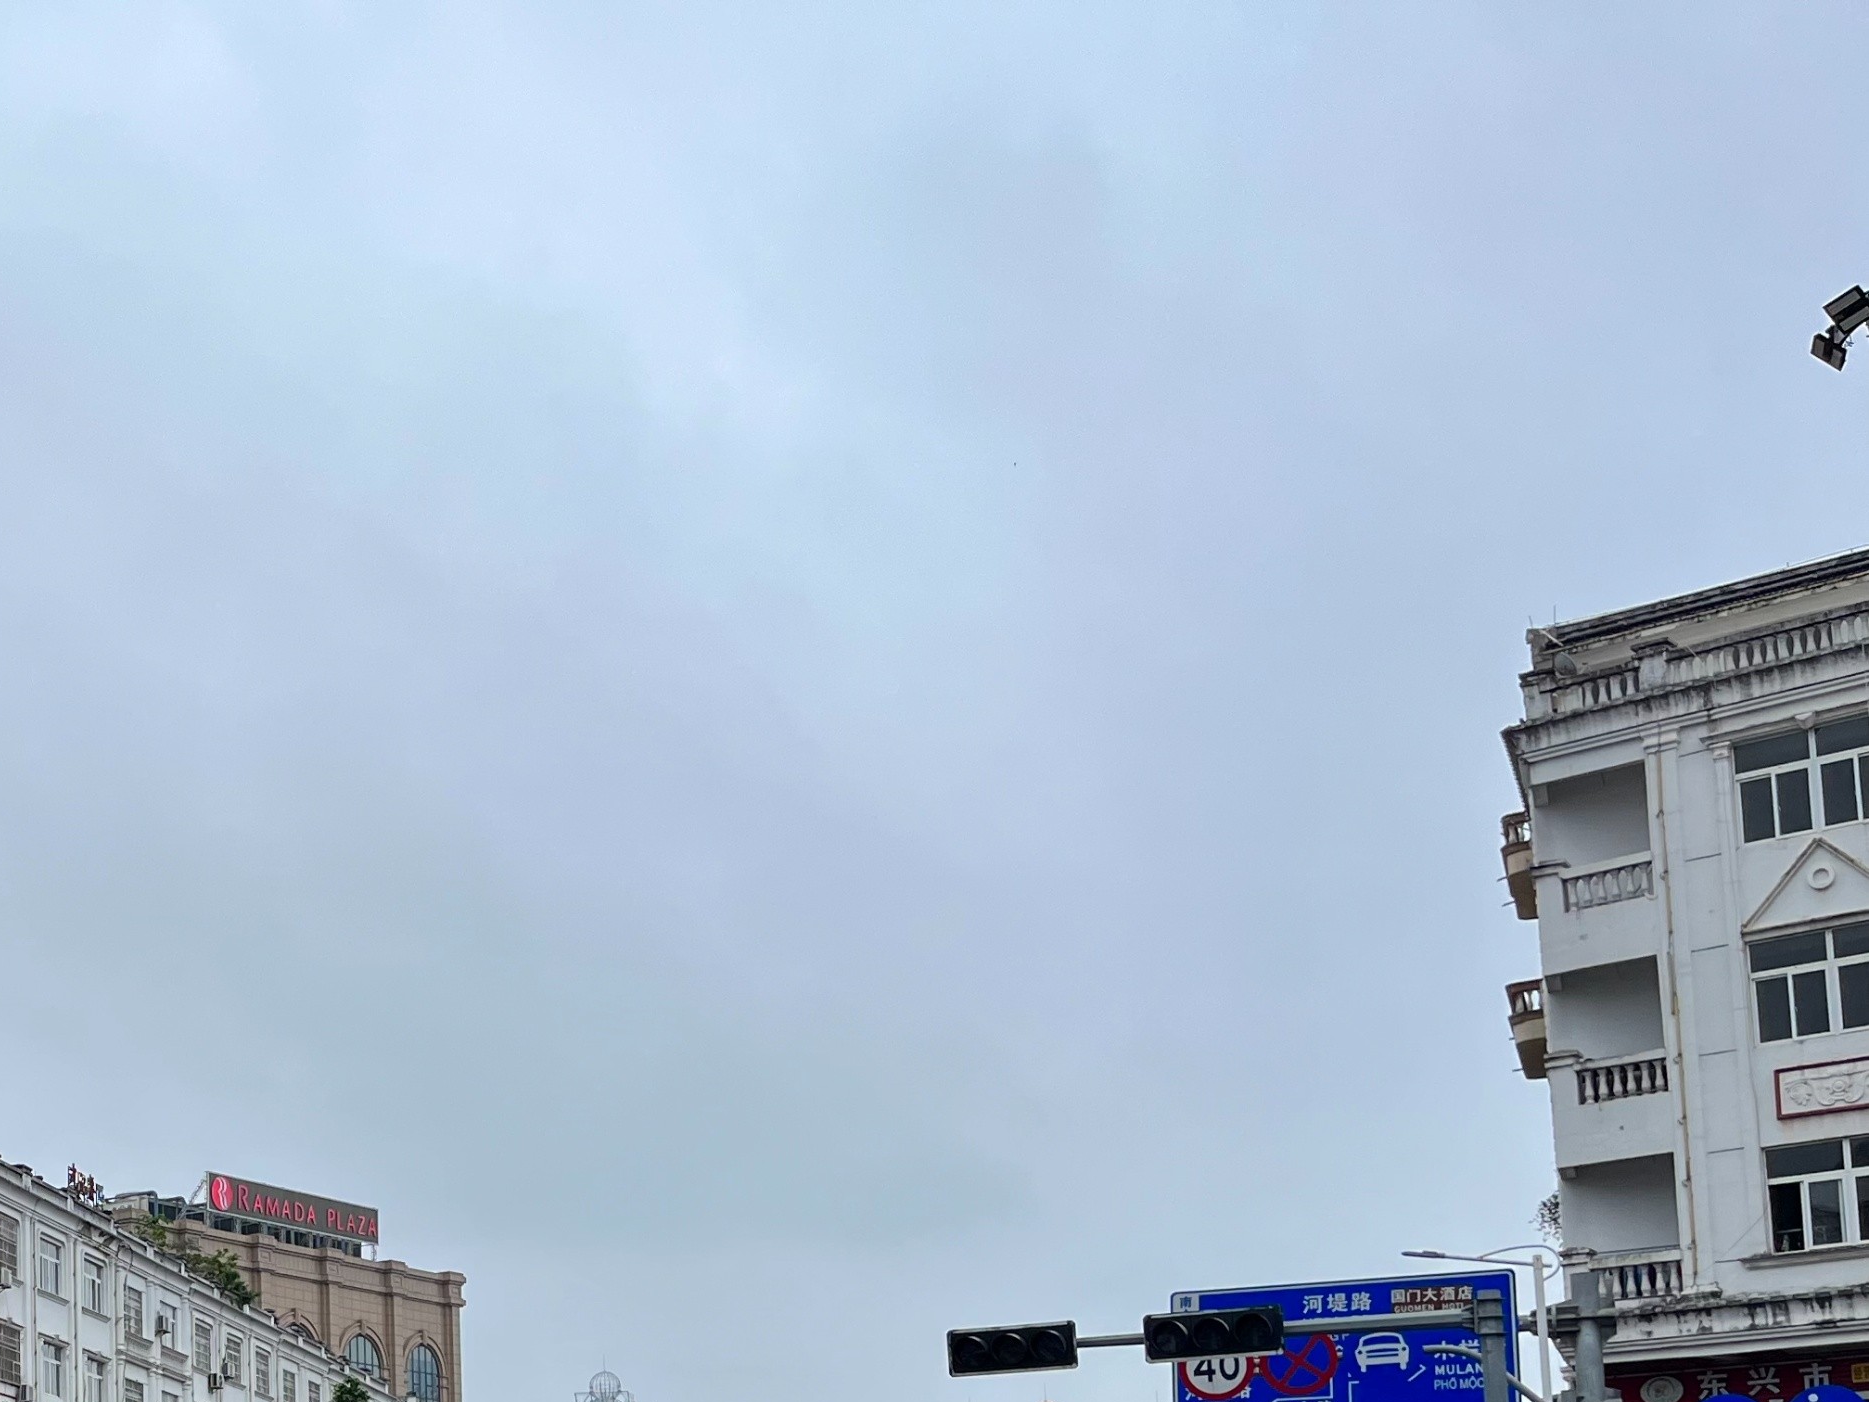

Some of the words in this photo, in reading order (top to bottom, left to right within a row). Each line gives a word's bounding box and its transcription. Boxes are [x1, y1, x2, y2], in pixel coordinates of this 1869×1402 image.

[237, 1184, 317, 1226] RAMADA
[327, 1208, 377, 1237] PLAZA
[1180, 1296, 1192, 1309] 南
[1303, 1291, 1372, 1314] 河堤路
[1391, 1286, 1474, 1304] 国门大酒店
[1394, 1304, 1435, 1314] GUOMEN
[1194, 1357, 1240, 1383] 40
[1697, 1362, 1833, 1400] 东兴市
